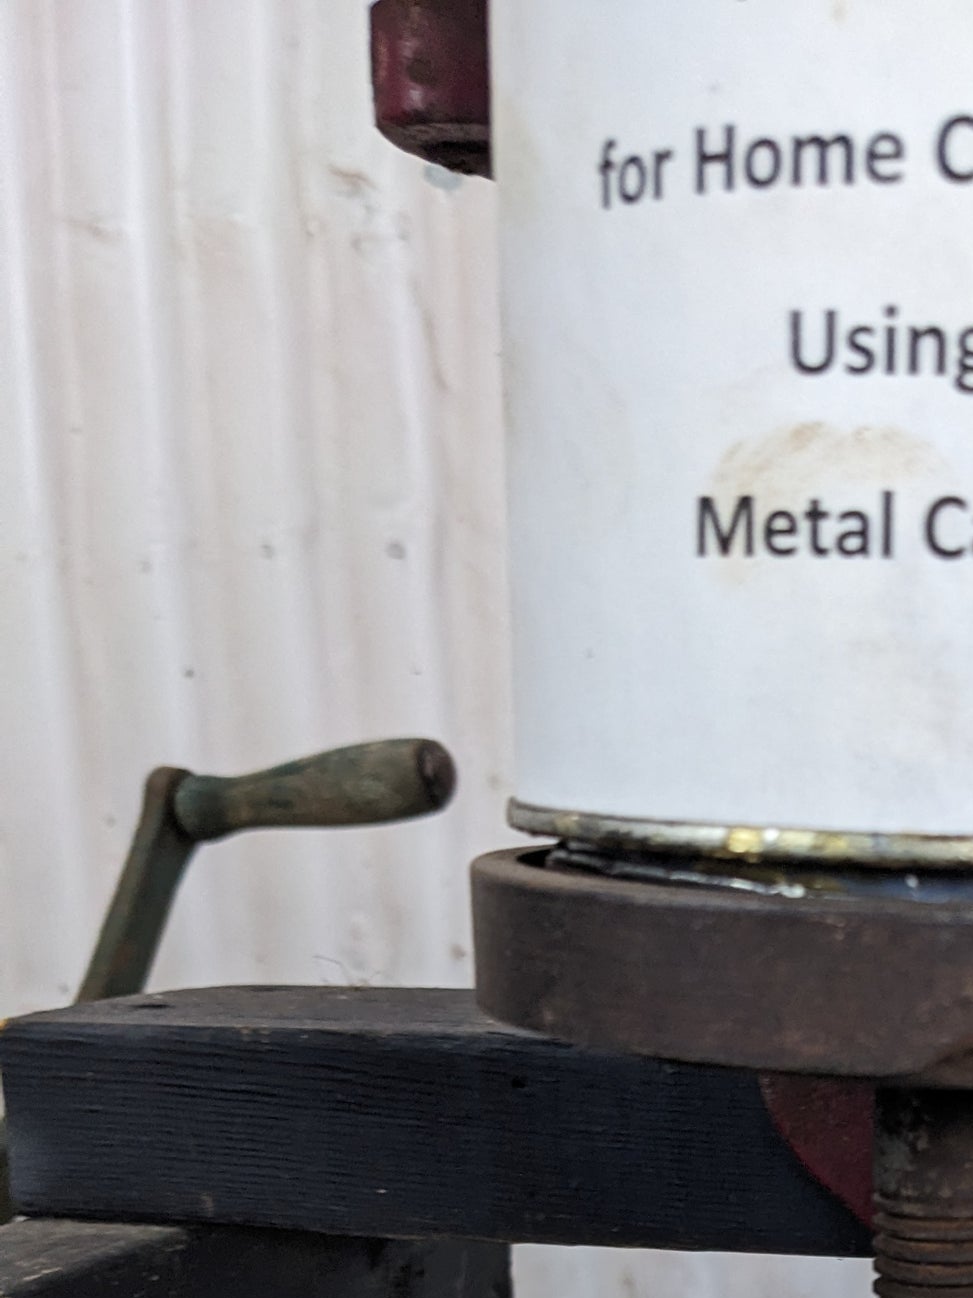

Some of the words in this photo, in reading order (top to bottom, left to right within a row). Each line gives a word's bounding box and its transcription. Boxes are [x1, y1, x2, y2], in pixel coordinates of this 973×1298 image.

[598, 138, 673, 208] for
[696, 124, 904, 194] Home
[696, 490, 893, 559] Metal
